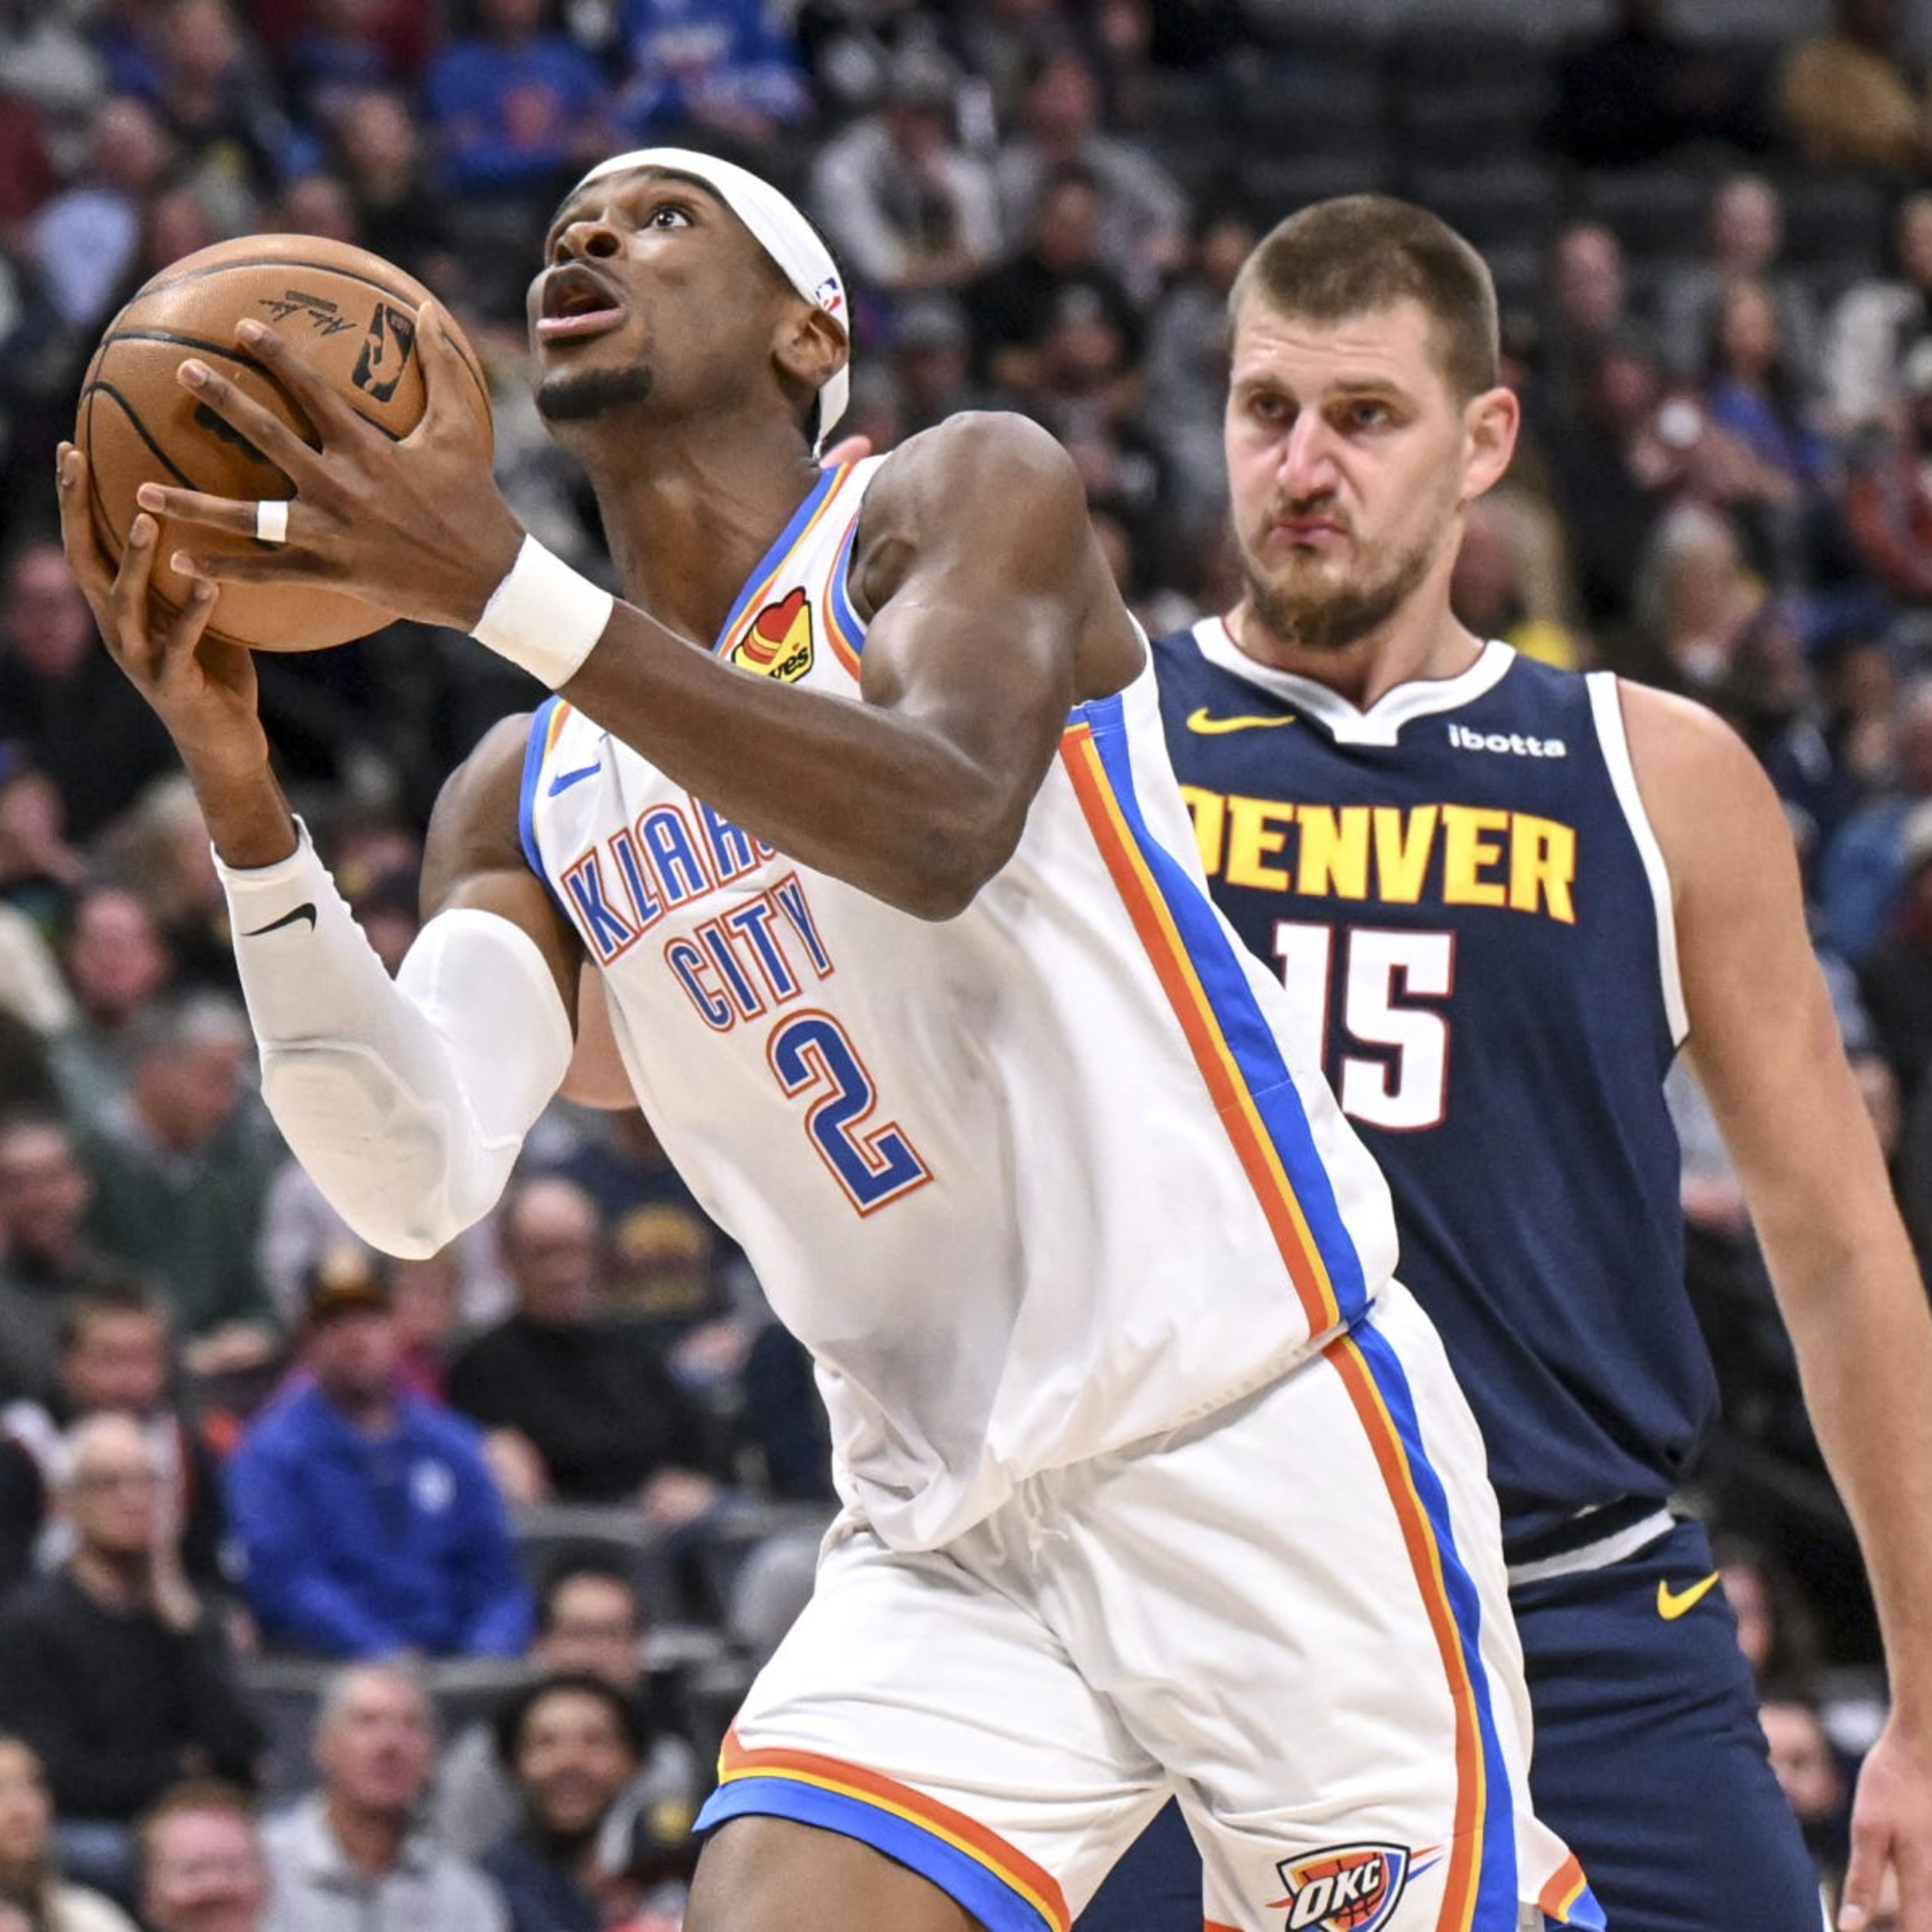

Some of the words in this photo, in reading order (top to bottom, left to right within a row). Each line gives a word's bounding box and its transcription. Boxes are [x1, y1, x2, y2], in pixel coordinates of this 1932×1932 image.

[663, 871, 835, 1032] CITY
[1272, 920, 1457, 1133] 15
[765, 1008, 934, 1219] 2
[1289, 1859, 1381, 1931] OKC
